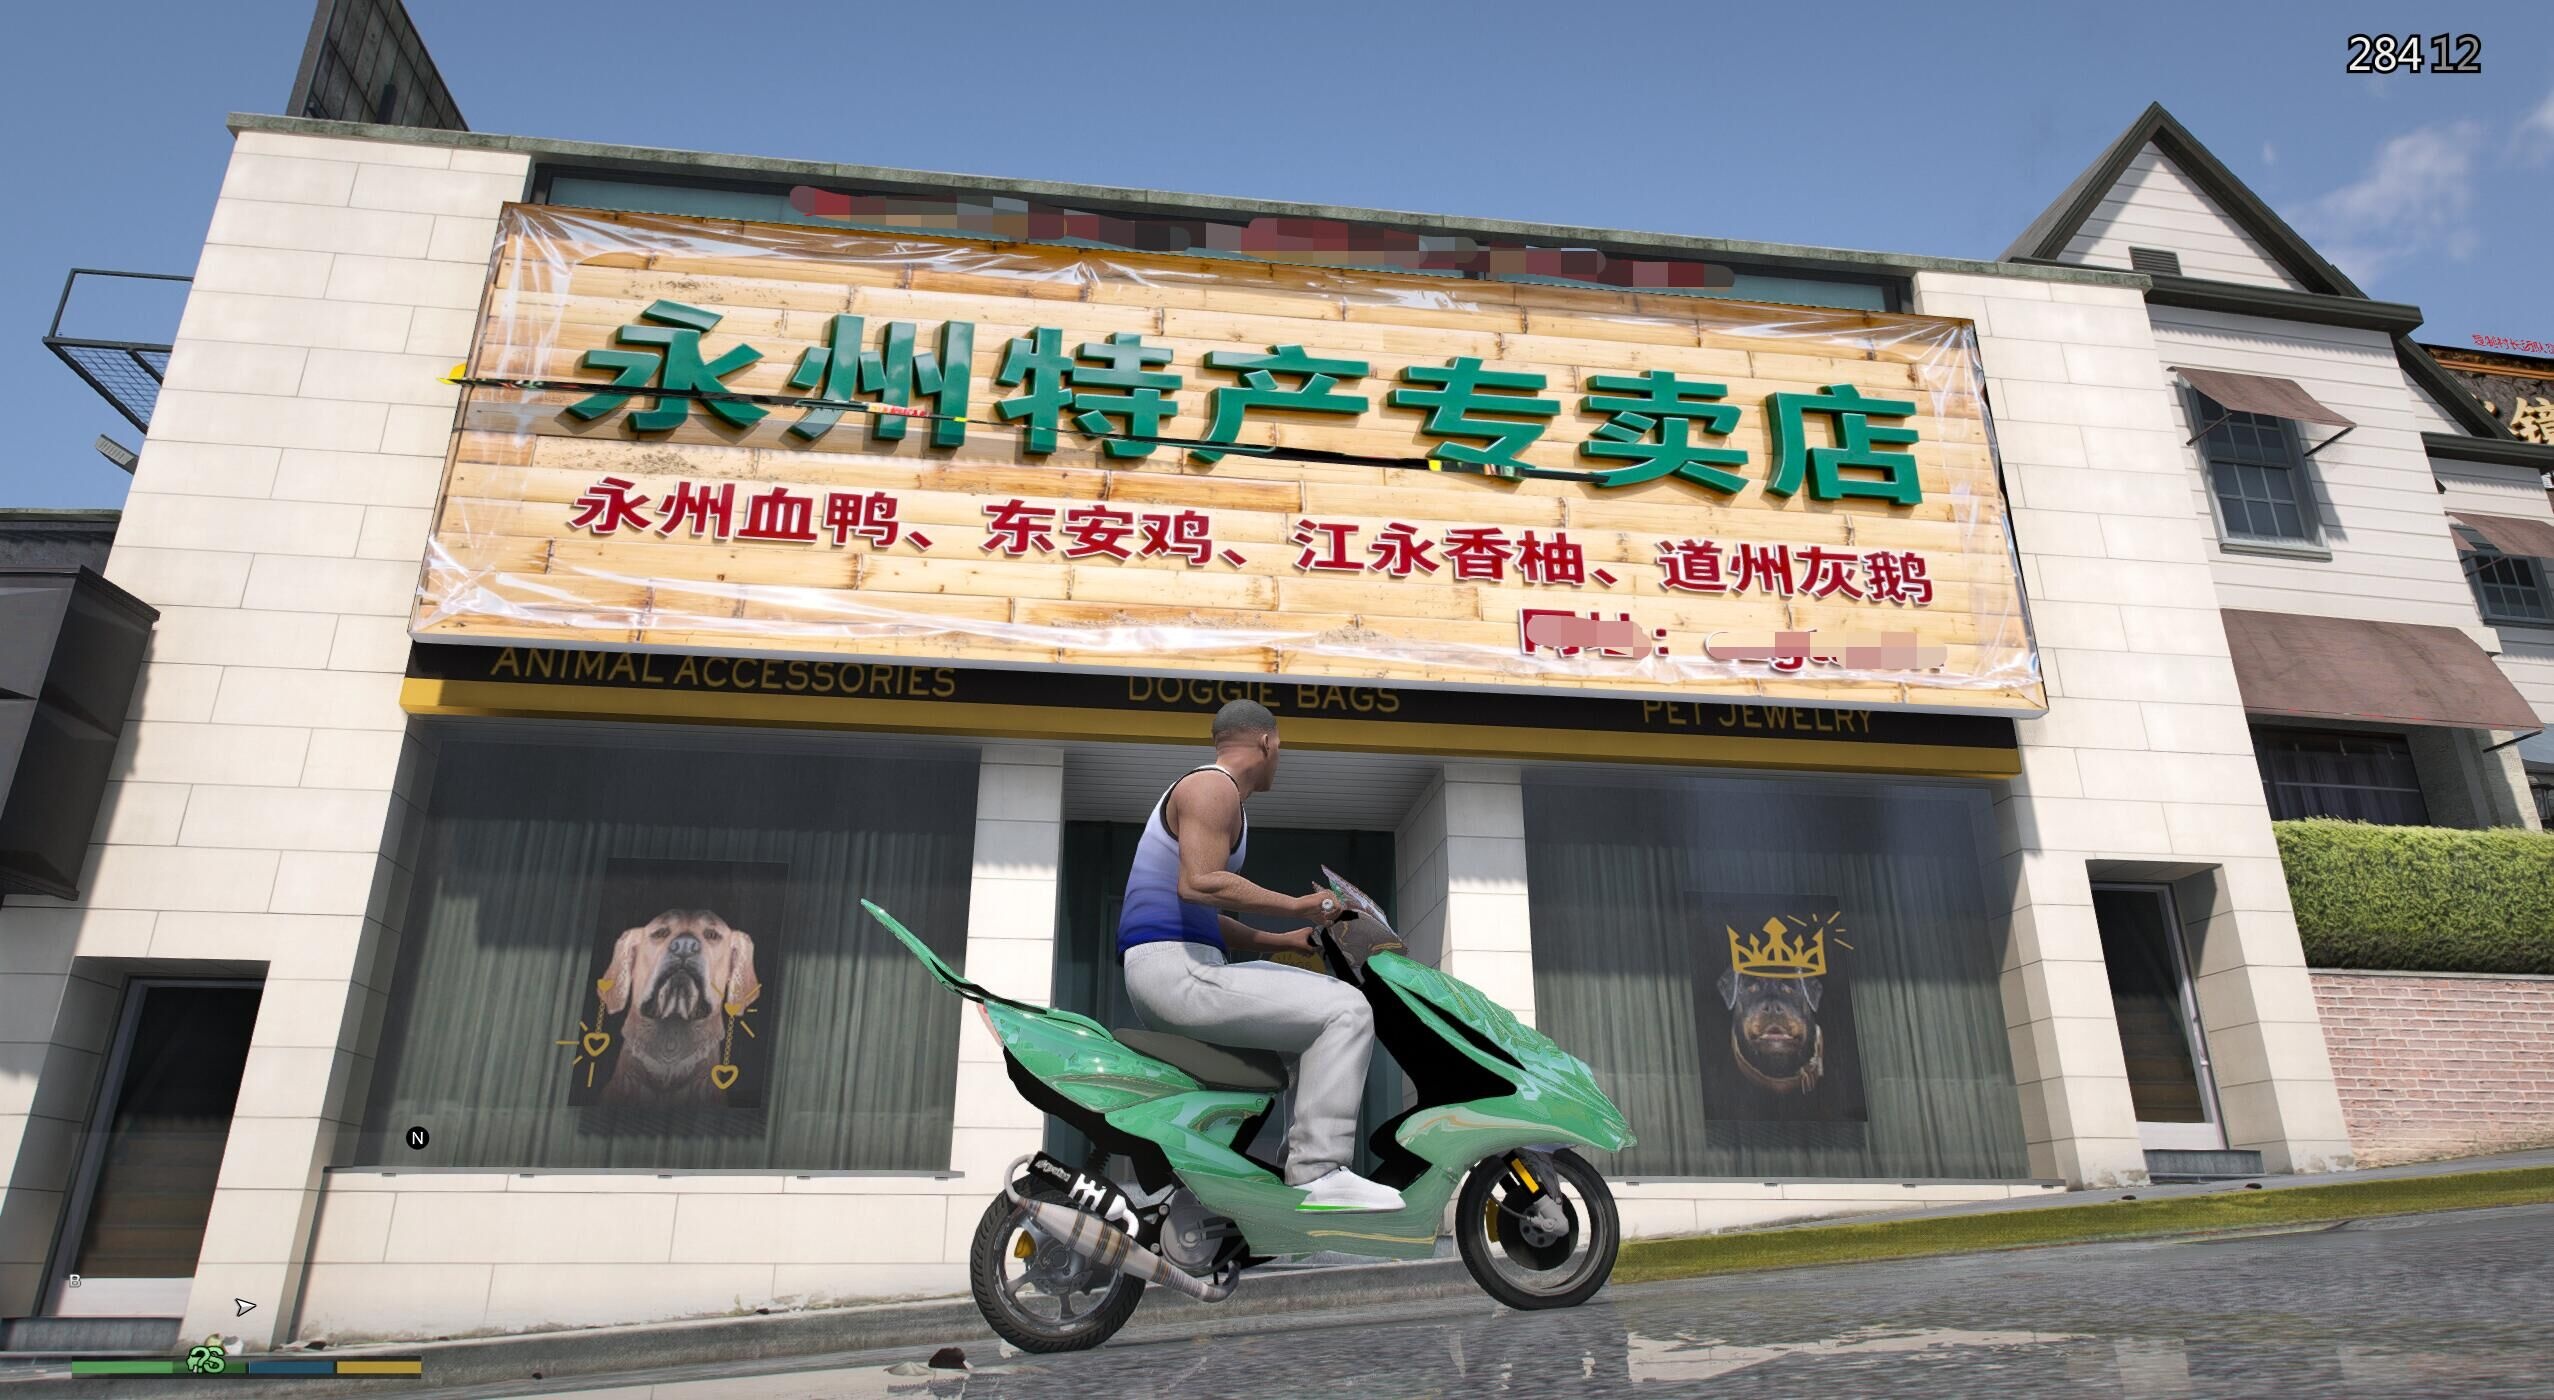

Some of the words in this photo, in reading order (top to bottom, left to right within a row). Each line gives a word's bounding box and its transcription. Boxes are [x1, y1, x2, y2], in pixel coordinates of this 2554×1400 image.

[565, 299, 1925, 508] 永州特产专卖店
[568, 474, 1936, 608] 永州血鸭、东安鸡、江永香柚、道州灰鹅
[490, 646, 663, 683] ANIMAL
[674, 655, 955, 697] ACCESSORIES
[1128, 676, 1281, 707] DOGGIE
[1296, 684, 1400, 713] BAGS
[1718, 705, 1872, 733] JEWELRY
